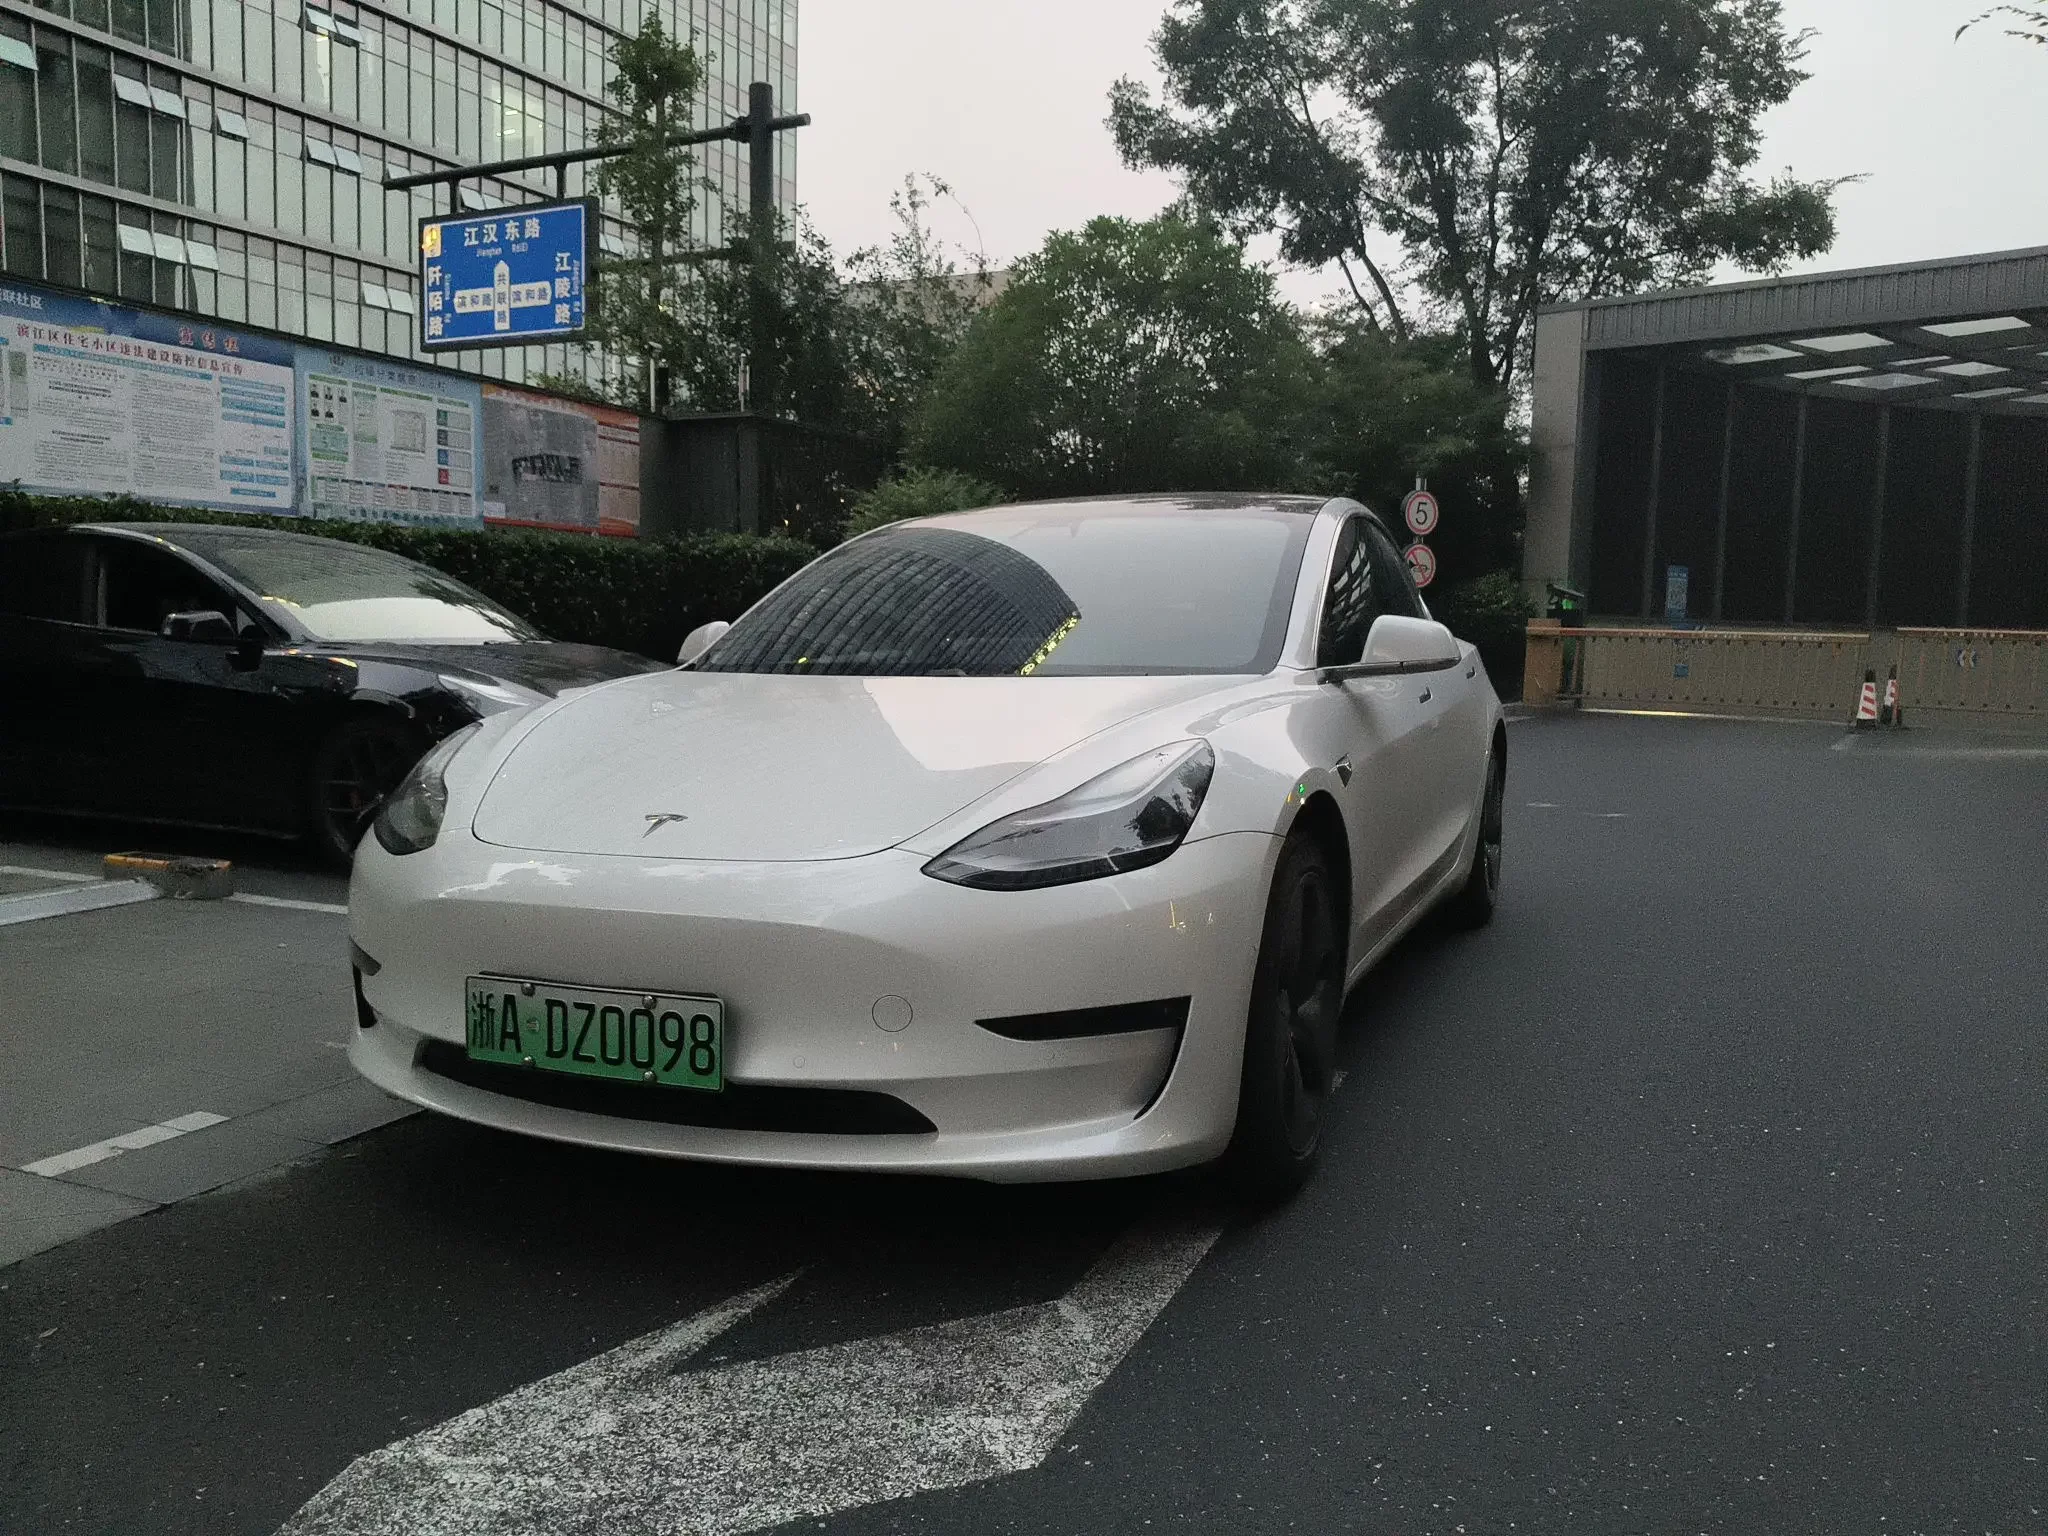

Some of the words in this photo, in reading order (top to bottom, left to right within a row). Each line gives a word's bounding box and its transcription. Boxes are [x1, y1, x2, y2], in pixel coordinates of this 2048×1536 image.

[464, 217, 540, 246] 江汉东路
[0, 288, 42, 309] 联社区
[428, 265, 443, 336] 阡陌路
[555, 252, 571, 324] 江陵路
[1416, 501, 1428, 526] 5
[472, 990, 522, 1054] 浙A
[545, 997, 716, 1077] DZ0098
